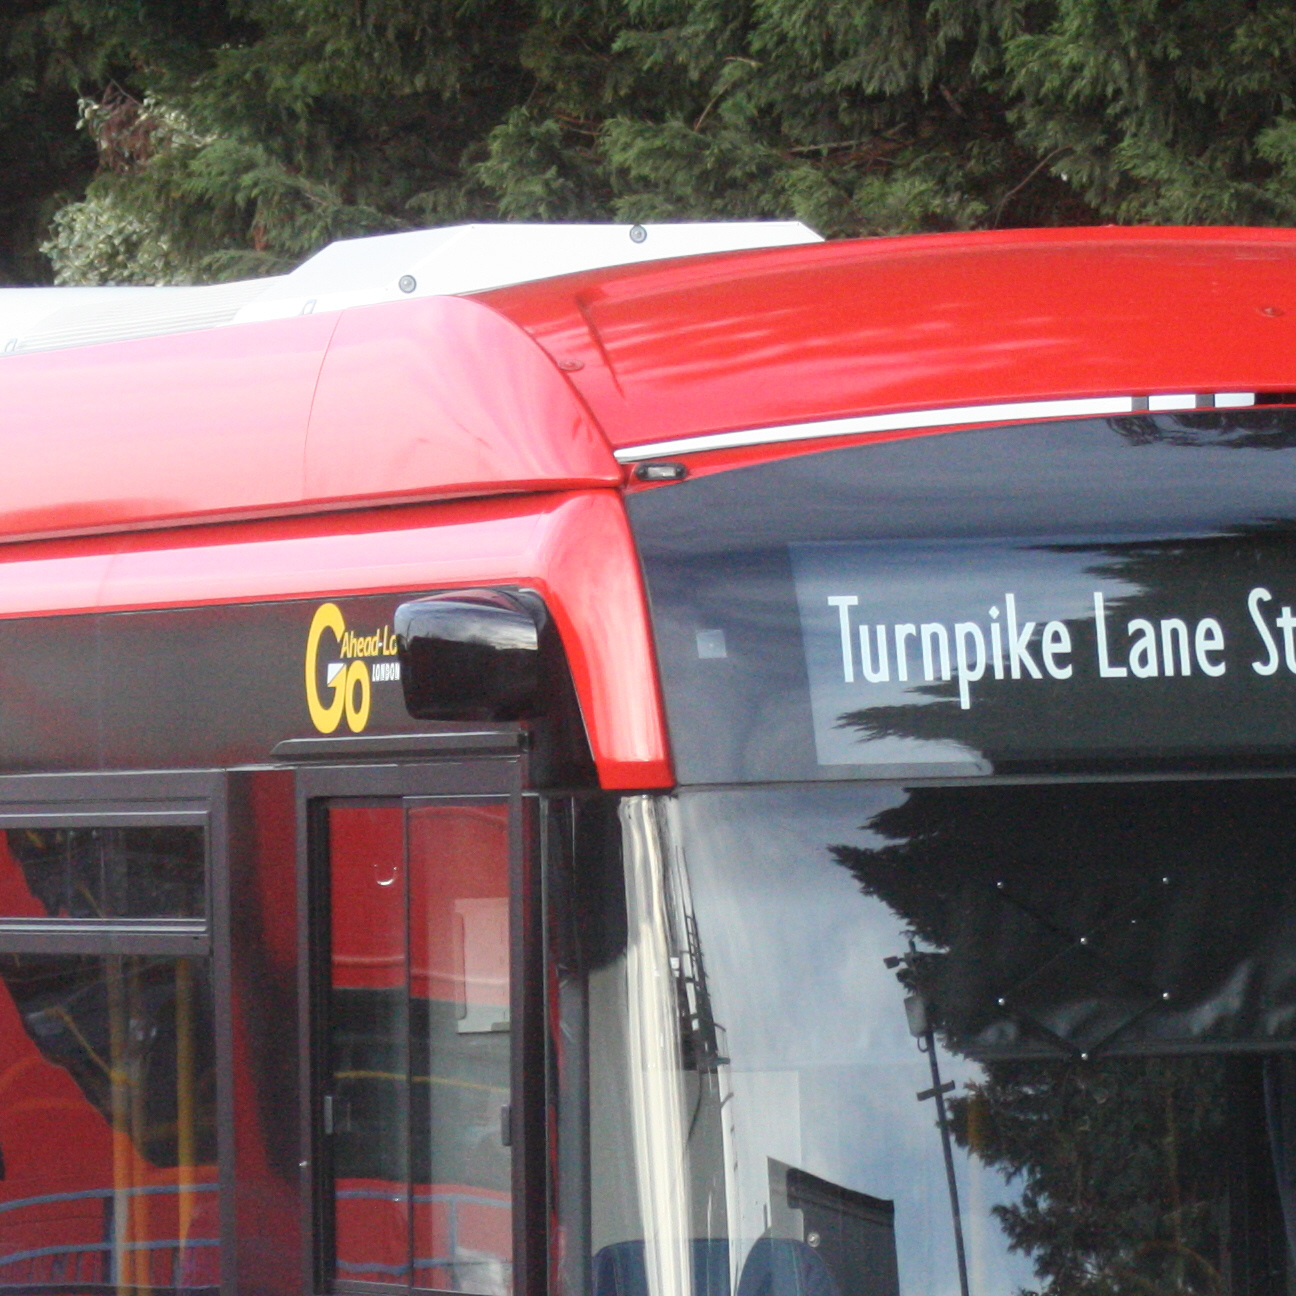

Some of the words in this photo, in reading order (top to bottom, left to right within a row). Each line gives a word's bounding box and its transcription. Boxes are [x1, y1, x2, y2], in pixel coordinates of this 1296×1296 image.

[305, 602, 371, 734] Go
[340, 624, 399, 659] Ahead-Lo
[827, 594, 1073, 711] Turnpike
[1093, 590, 1226, 680] Lane
